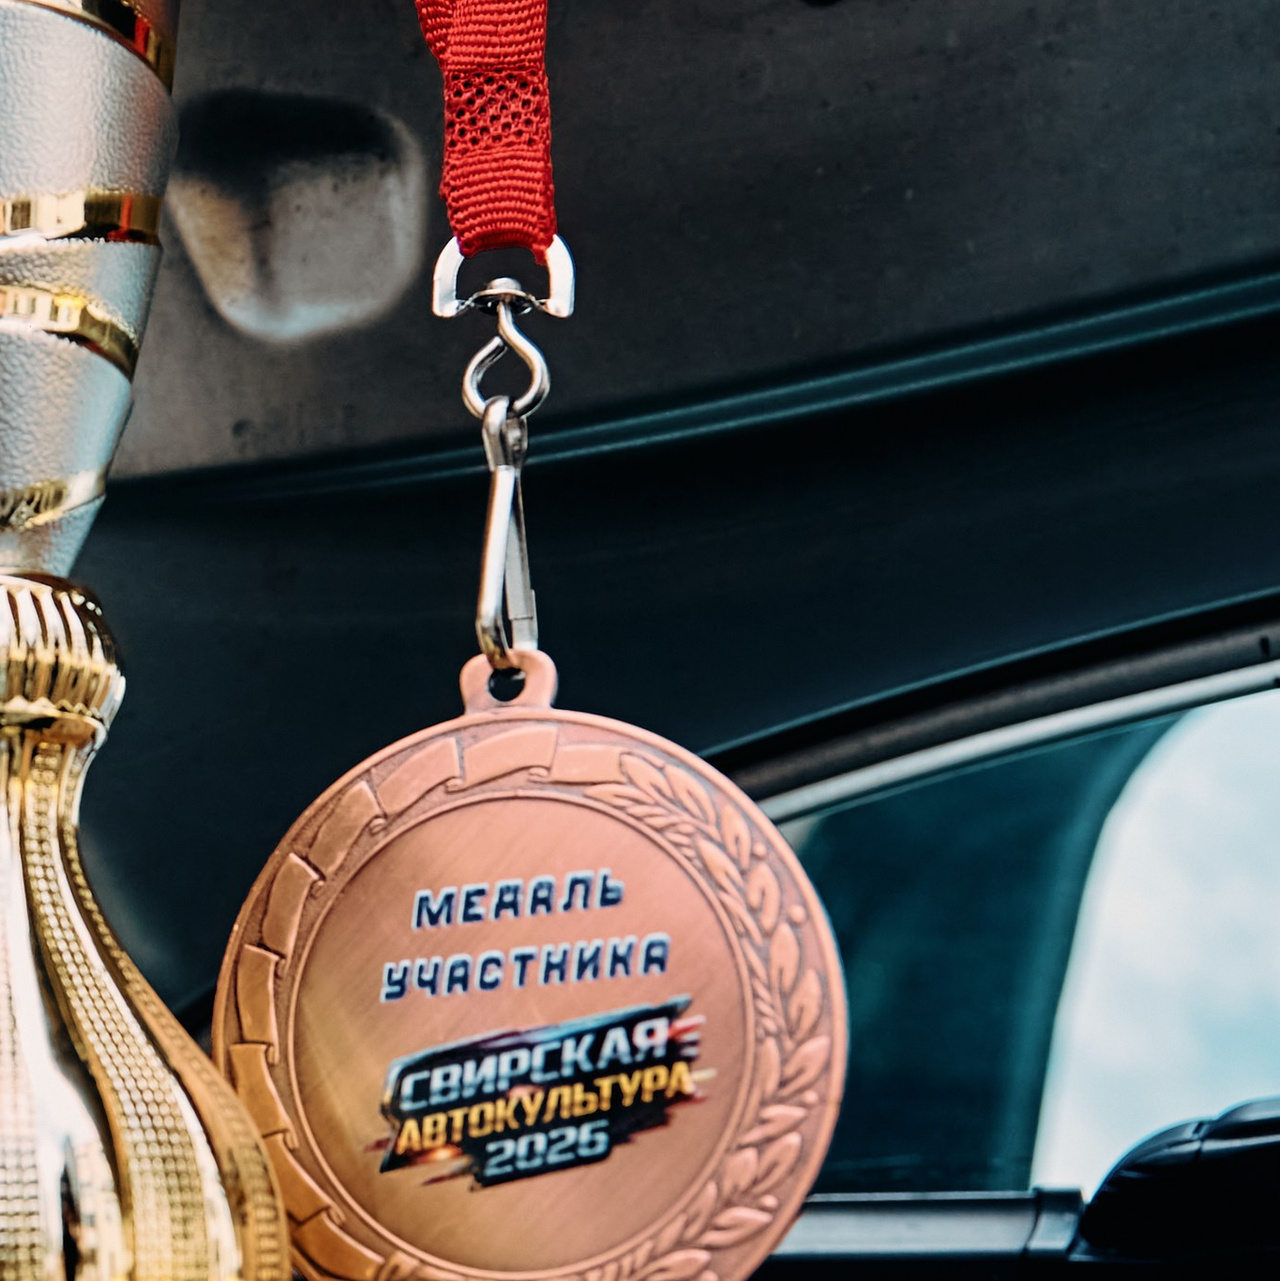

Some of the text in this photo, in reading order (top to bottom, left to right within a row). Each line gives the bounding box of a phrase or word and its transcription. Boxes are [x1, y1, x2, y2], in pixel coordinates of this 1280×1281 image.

[411, 867, 625, 930] МЕДАЛЬ
[380, 932, 672, 1003] УЧАСТНИКА
[400, 1017, 673, 1111] СВИРСКАЯ
[396, 1061, 693, 1154] АВТОКУЛЬТУРА
